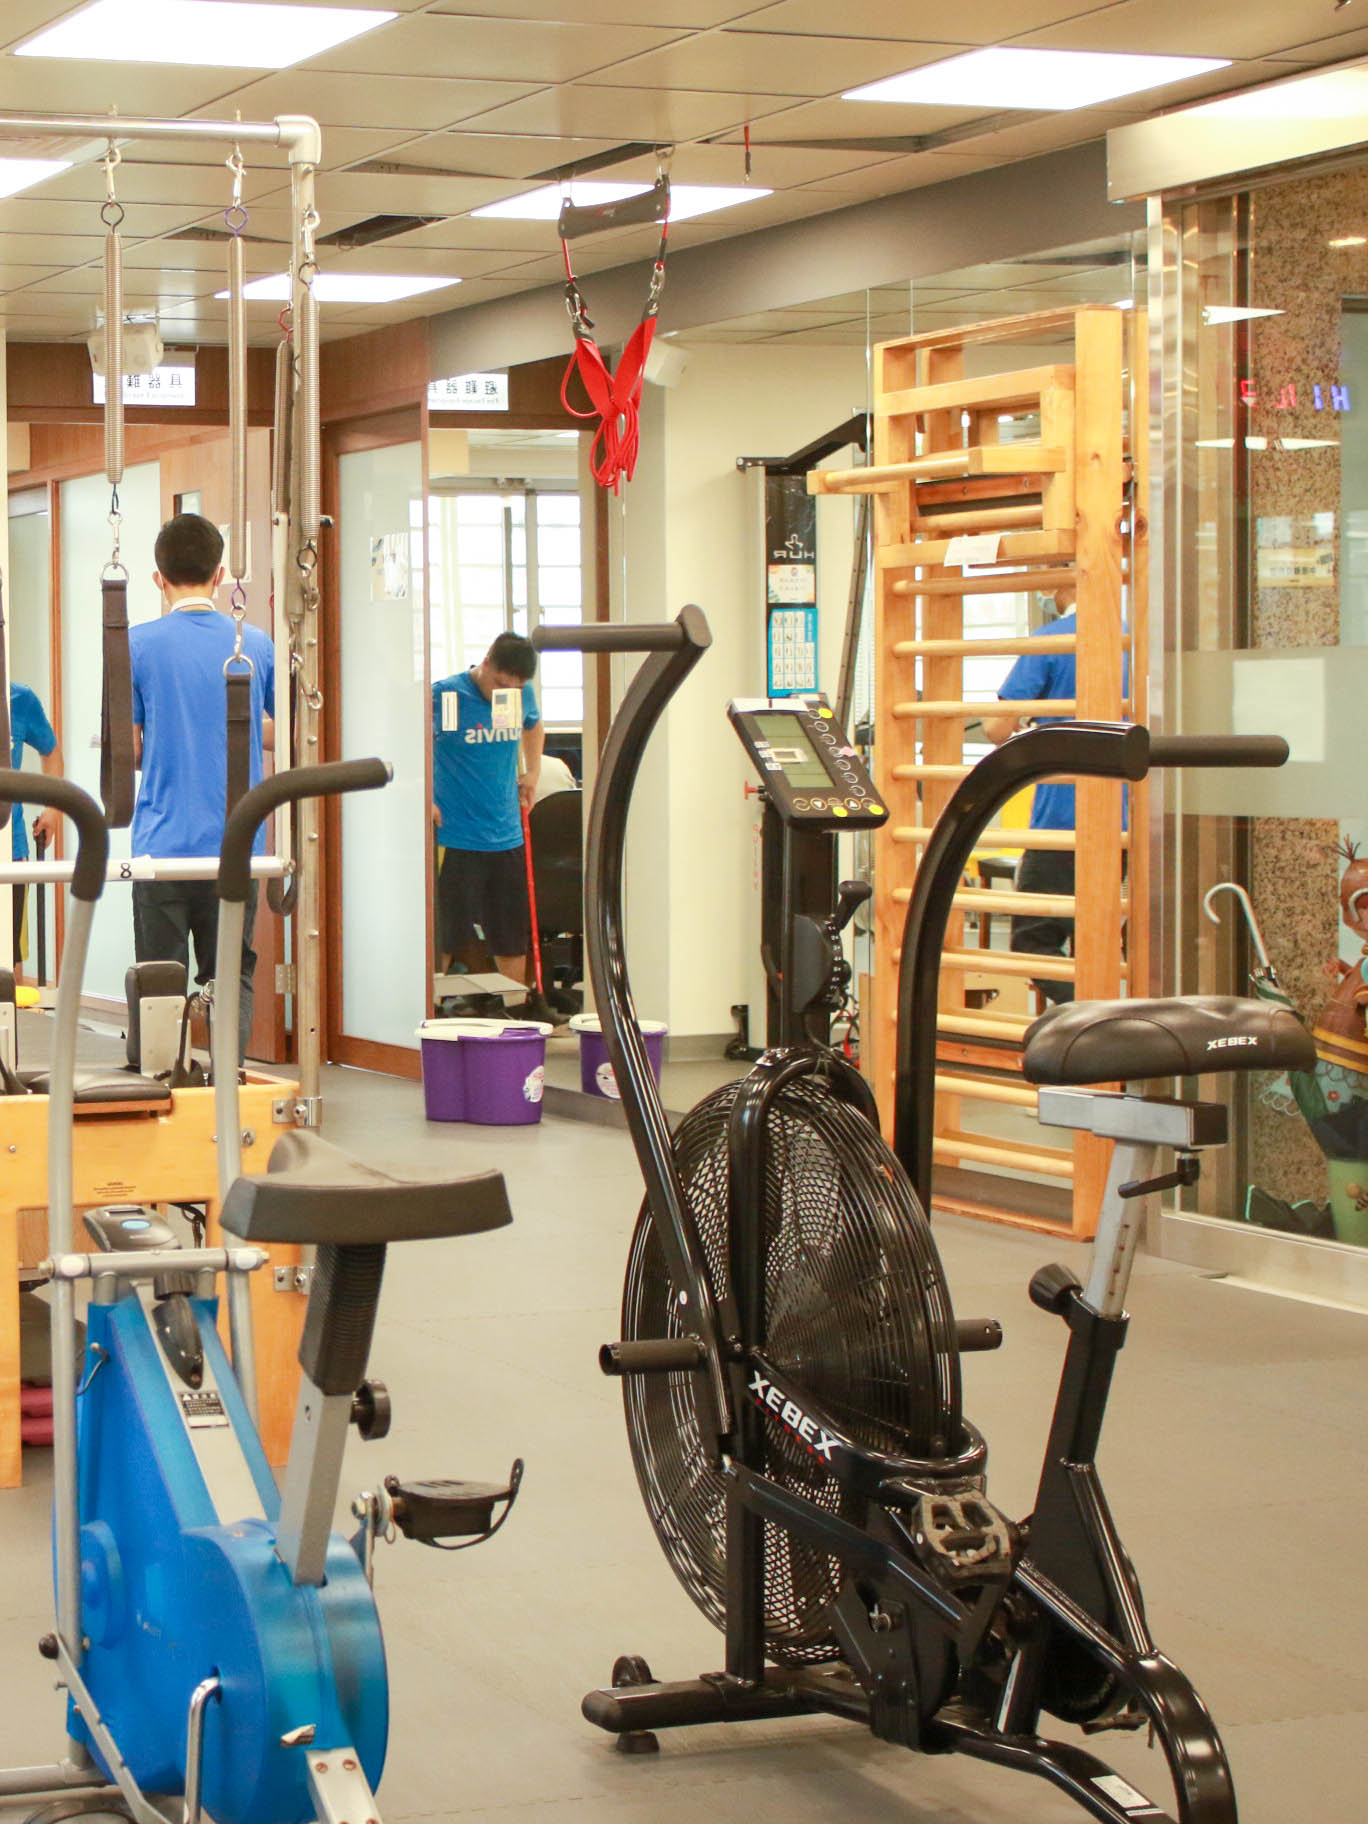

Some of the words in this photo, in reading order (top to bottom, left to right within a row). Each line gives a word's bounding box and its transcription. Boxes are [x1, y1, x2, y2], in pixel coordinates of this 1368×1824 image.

[126, 373, 184, 389] 難器具
[1206, 1036, 1258, 1051] XEBEX
[748, 1369, 842, 1461] XEBEX
